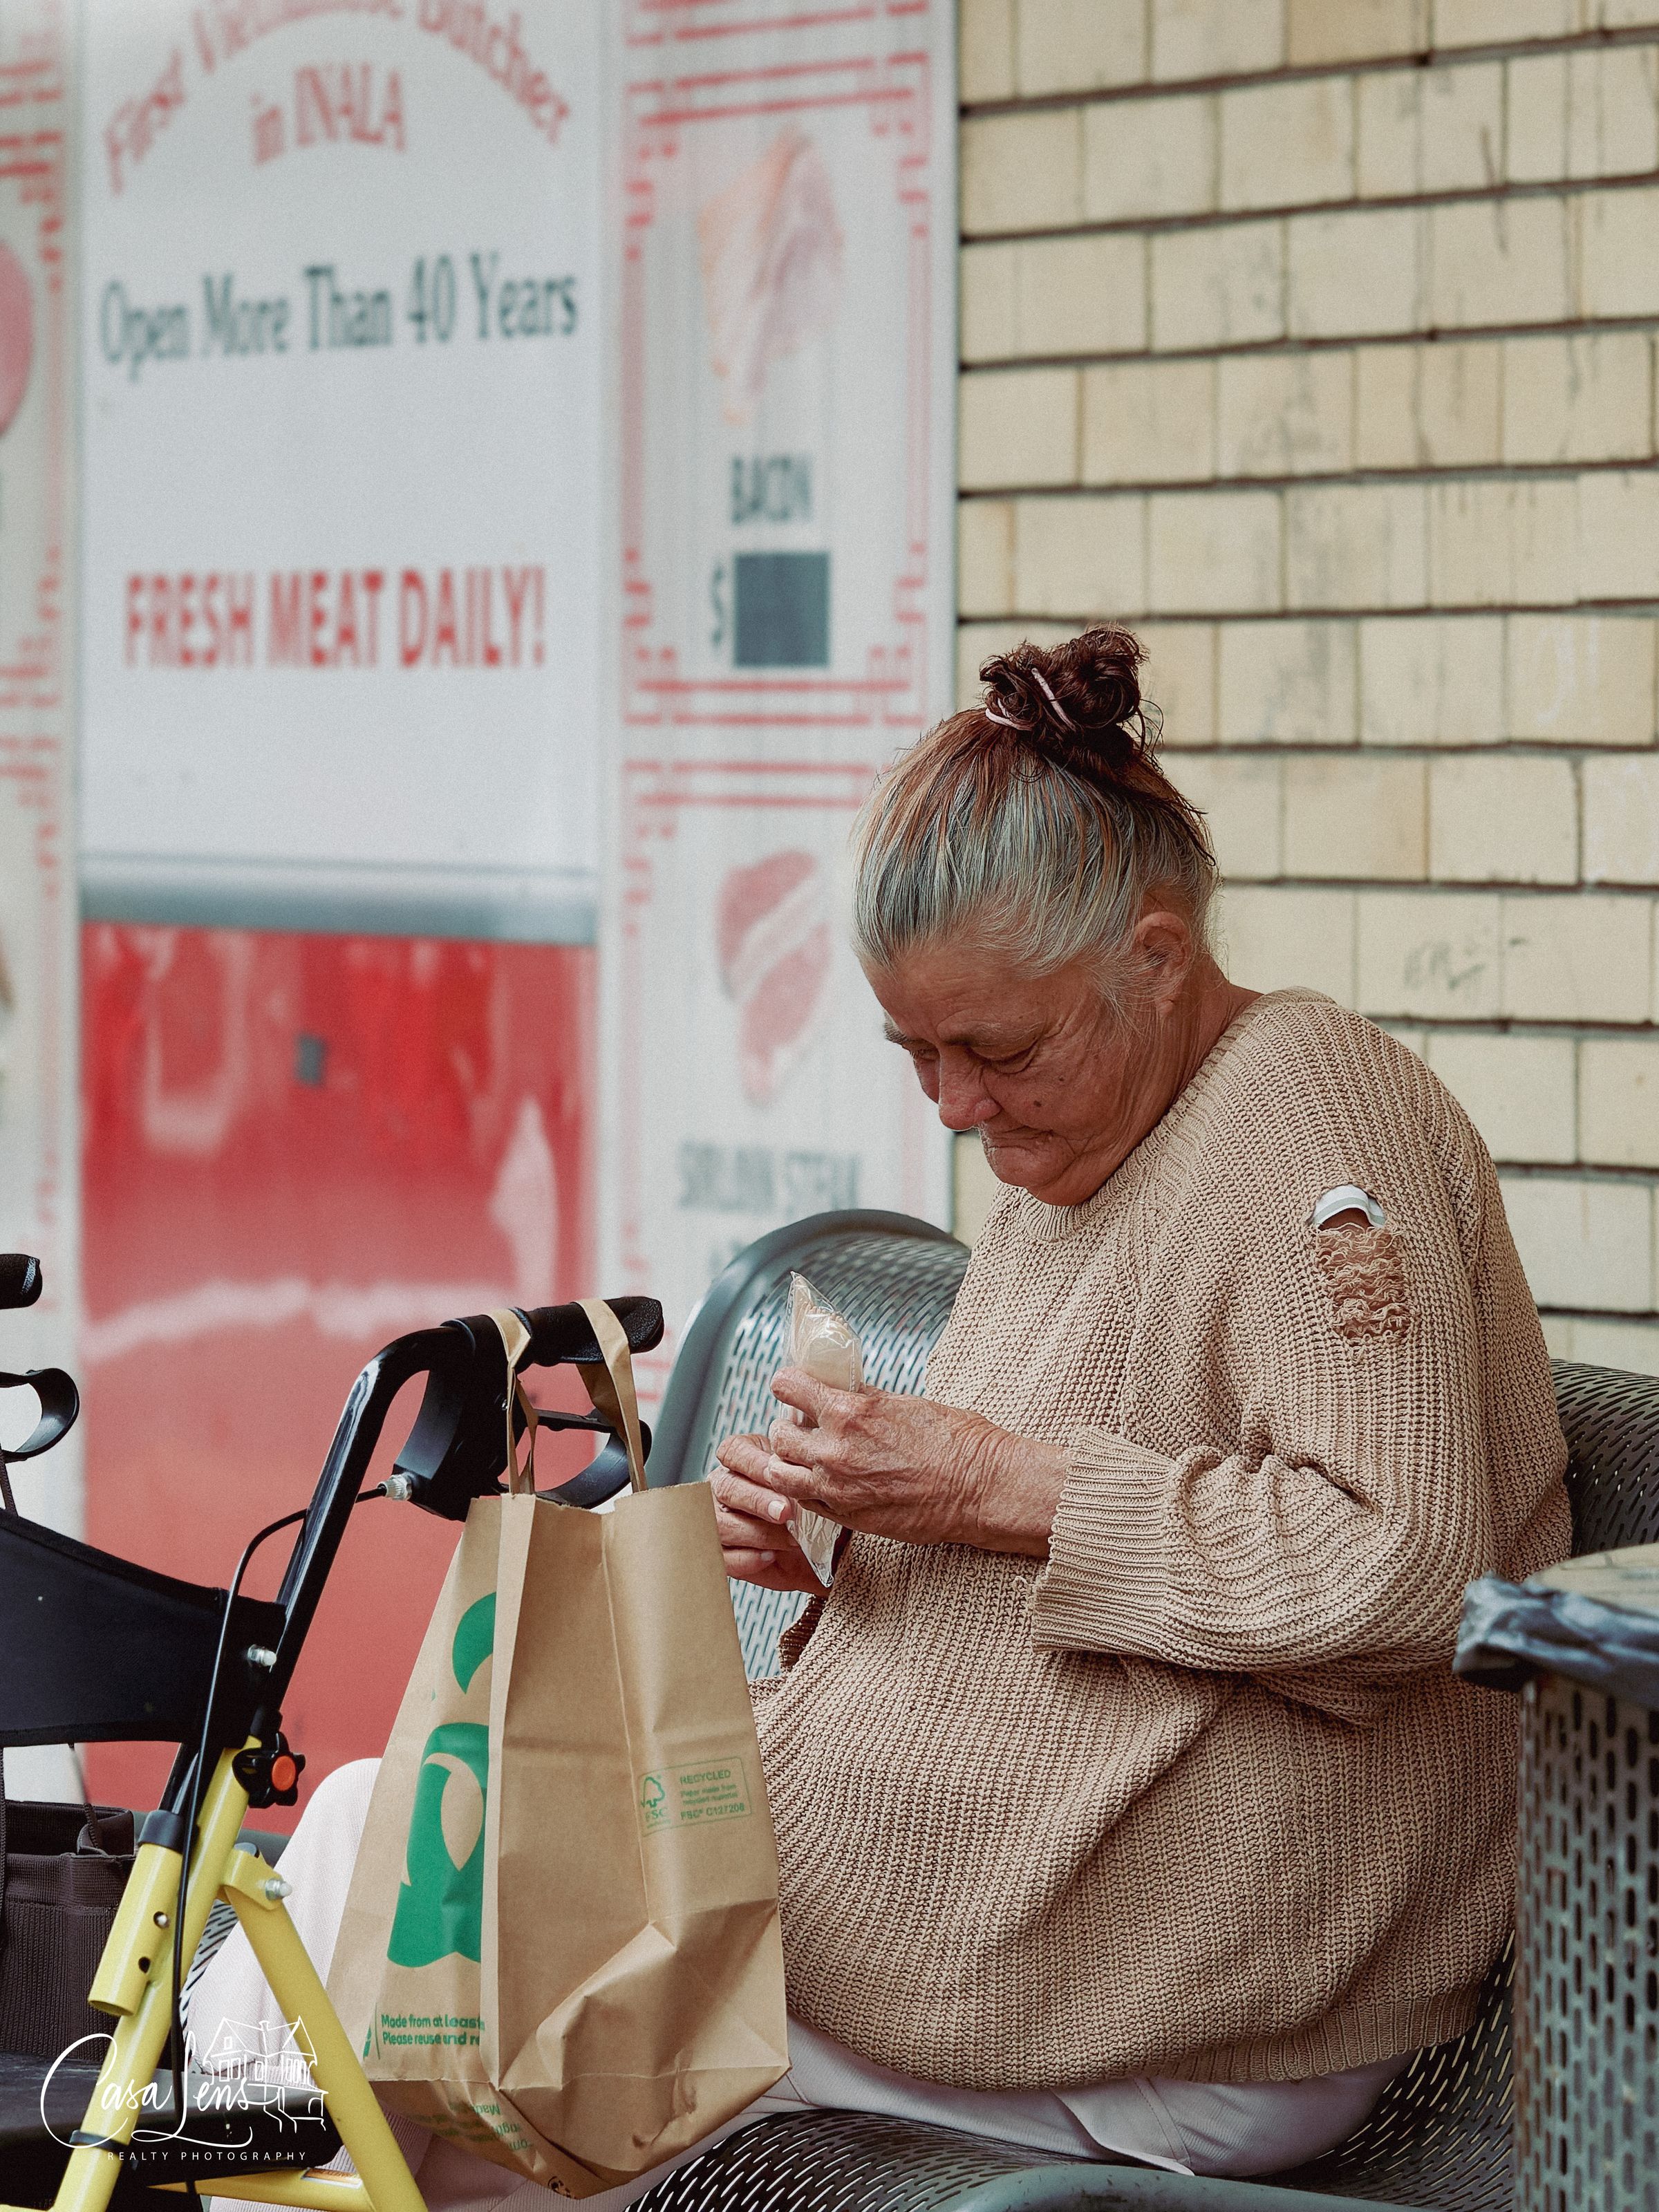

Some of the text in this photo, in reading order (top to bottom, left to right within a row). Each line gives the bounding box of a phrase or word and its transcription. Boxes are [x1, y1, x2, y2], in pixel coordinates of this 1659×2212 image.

[252, 61, 406, 167] in INALA
[102, 247, 579, 384] Open More Than 40 Years
[124, 563, 546, 669] FRESH MEAT DAILY!
[680, 1770, 731, 1784] RECYCLED
[381, 2014, 407, 2028] Made
[409, 2014, 431, 2027] from
[433, 2014, 443, 2027] at
[382, 2031, 413, 2045] Please
[414, 2033, 441, 2045] reuse
[442, 2032, 467, 2045] and
